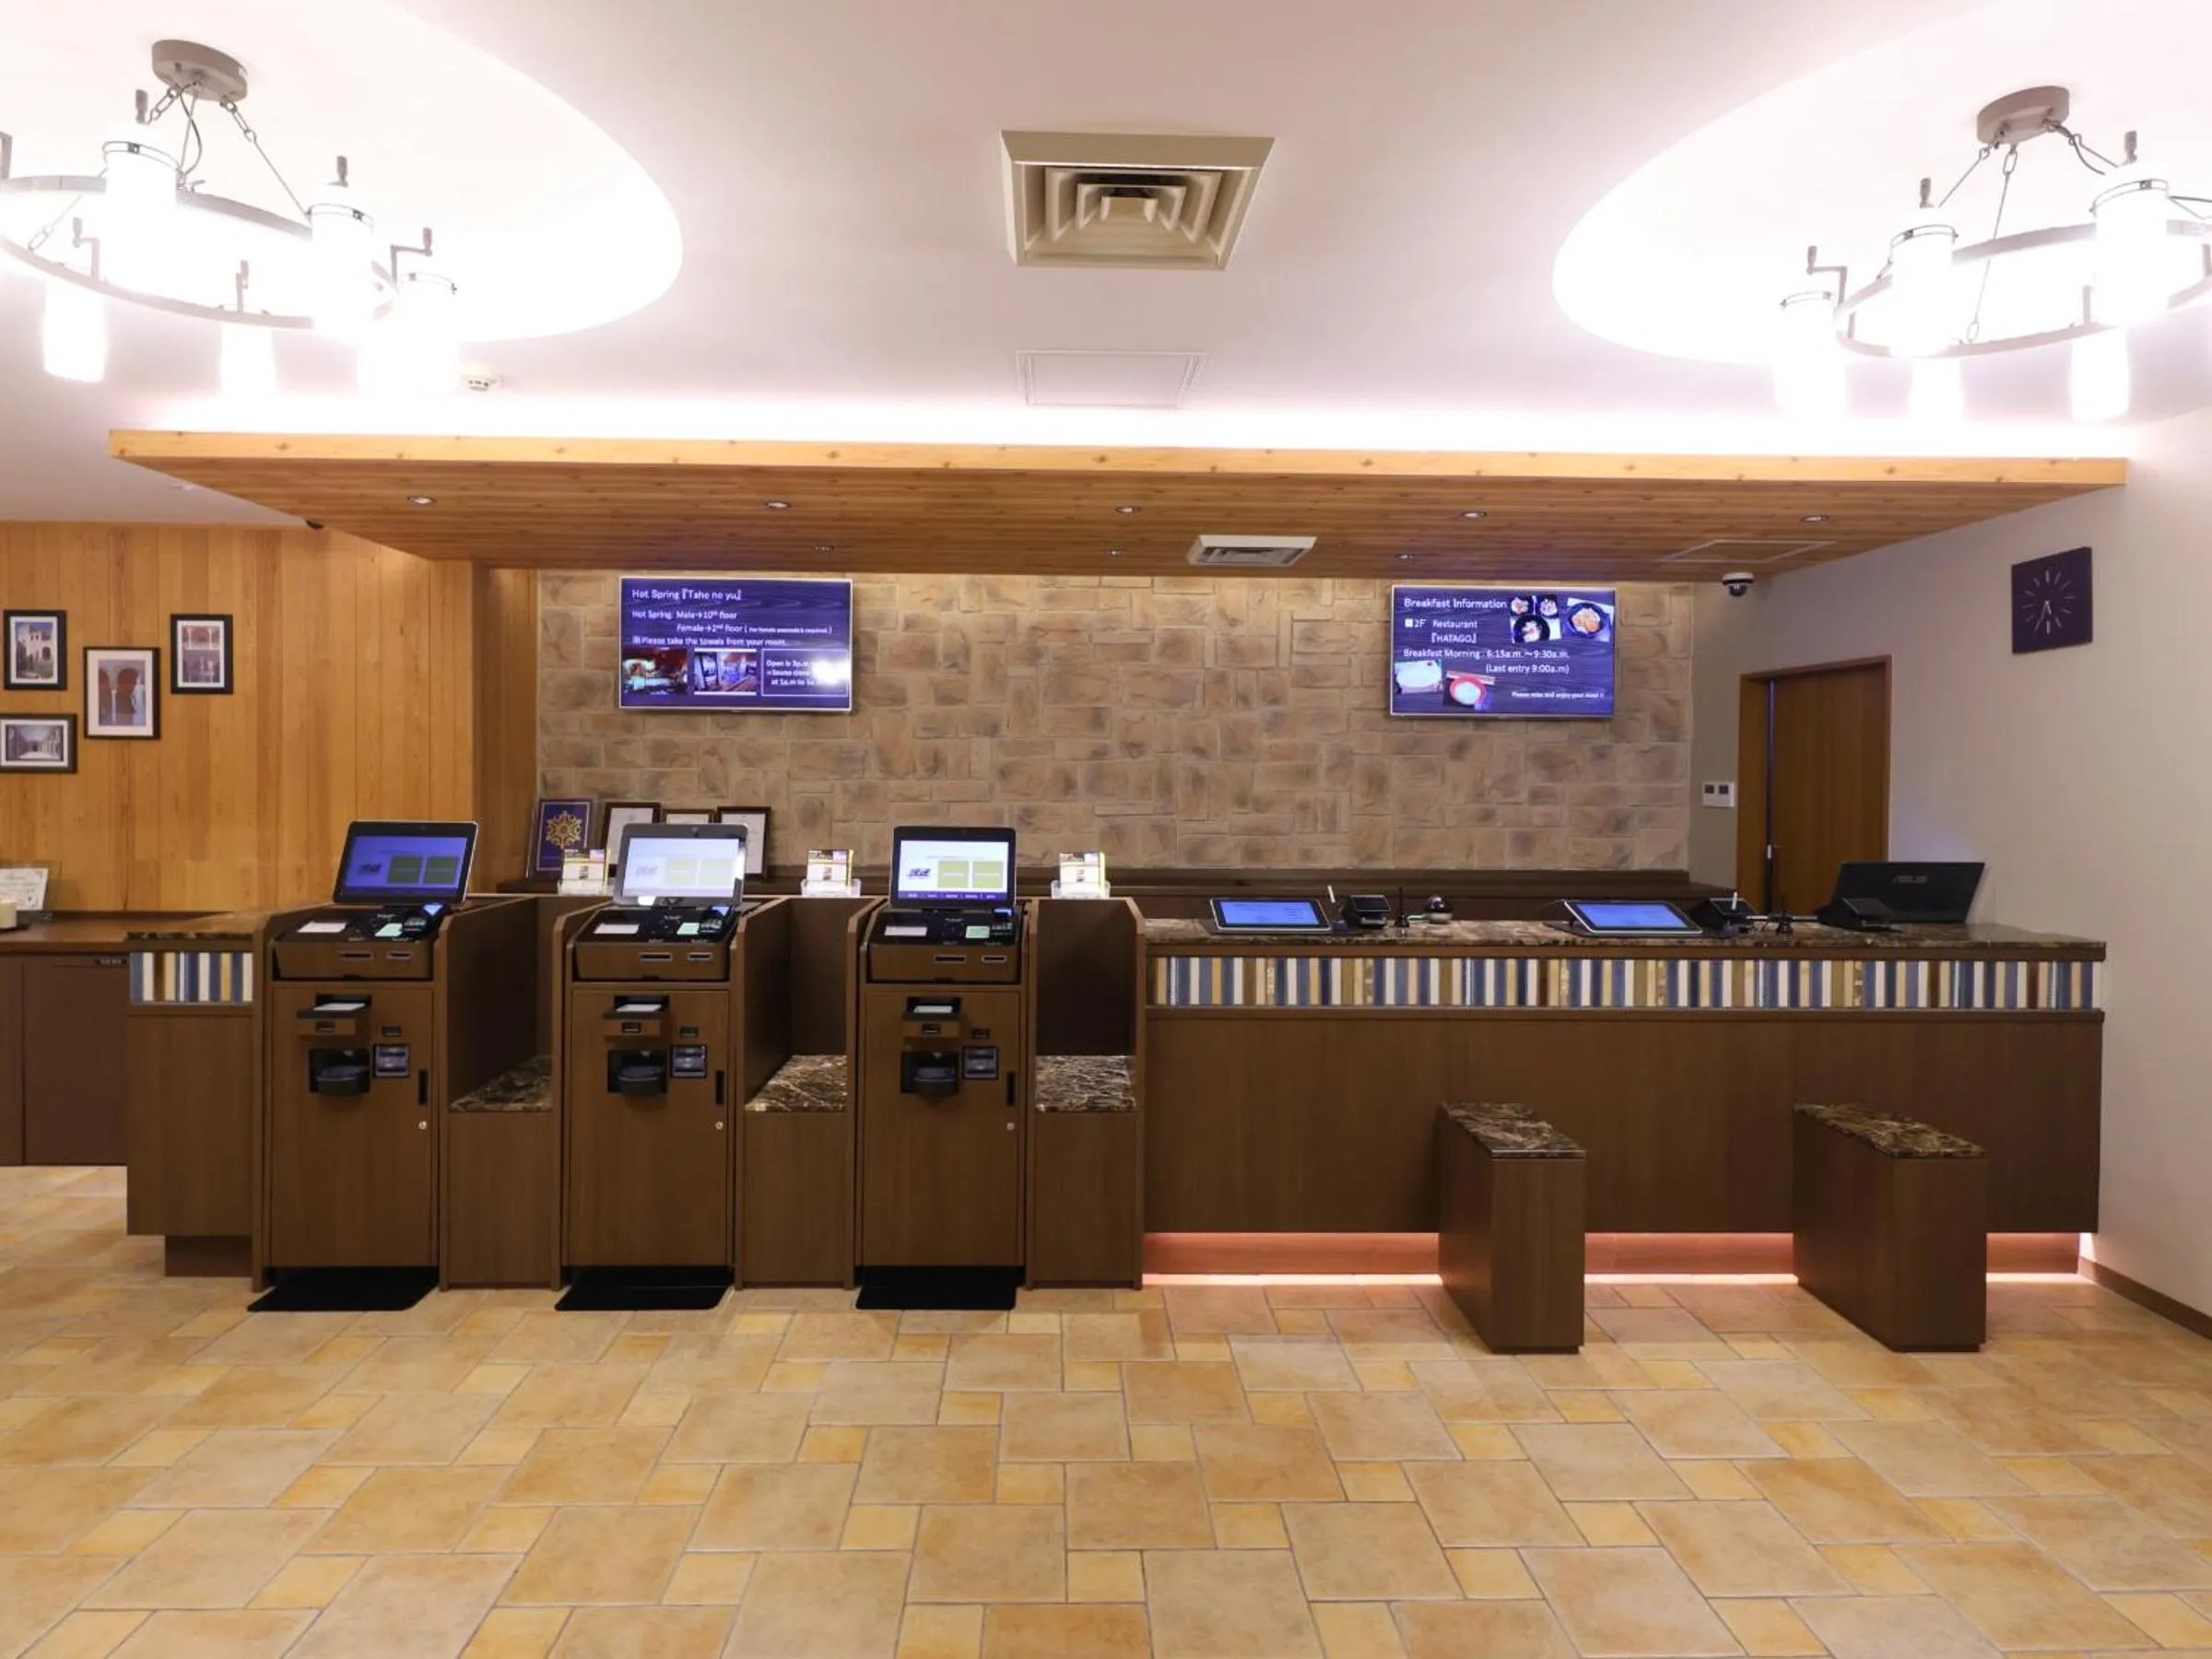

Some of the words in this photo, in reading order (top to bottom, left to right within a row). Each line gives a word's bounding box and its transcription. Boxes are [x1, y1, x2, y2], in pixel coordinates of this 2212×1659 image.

[631, 590, 649, 598] Hot
[651, 589, 679, 600] Spring
[712, 591, 724, 599] no
[1404, 598, 1451, 608] Breakfast
[1453, 598, 1508, 608] Information
[719, 611, 737, 619] floor
[1414, 618, 1426, 628] 2F
[1432, 619, 1477, 629] Restaurant
[667, 637, 684, 645] take
[685, 637, 698, 645] the
[726, 636, 745, 645] from
[747, 639, 763, 647] your
[1404, 649, 1441, 657] Breakfast
[1508, 665, 1530, 676] entry
